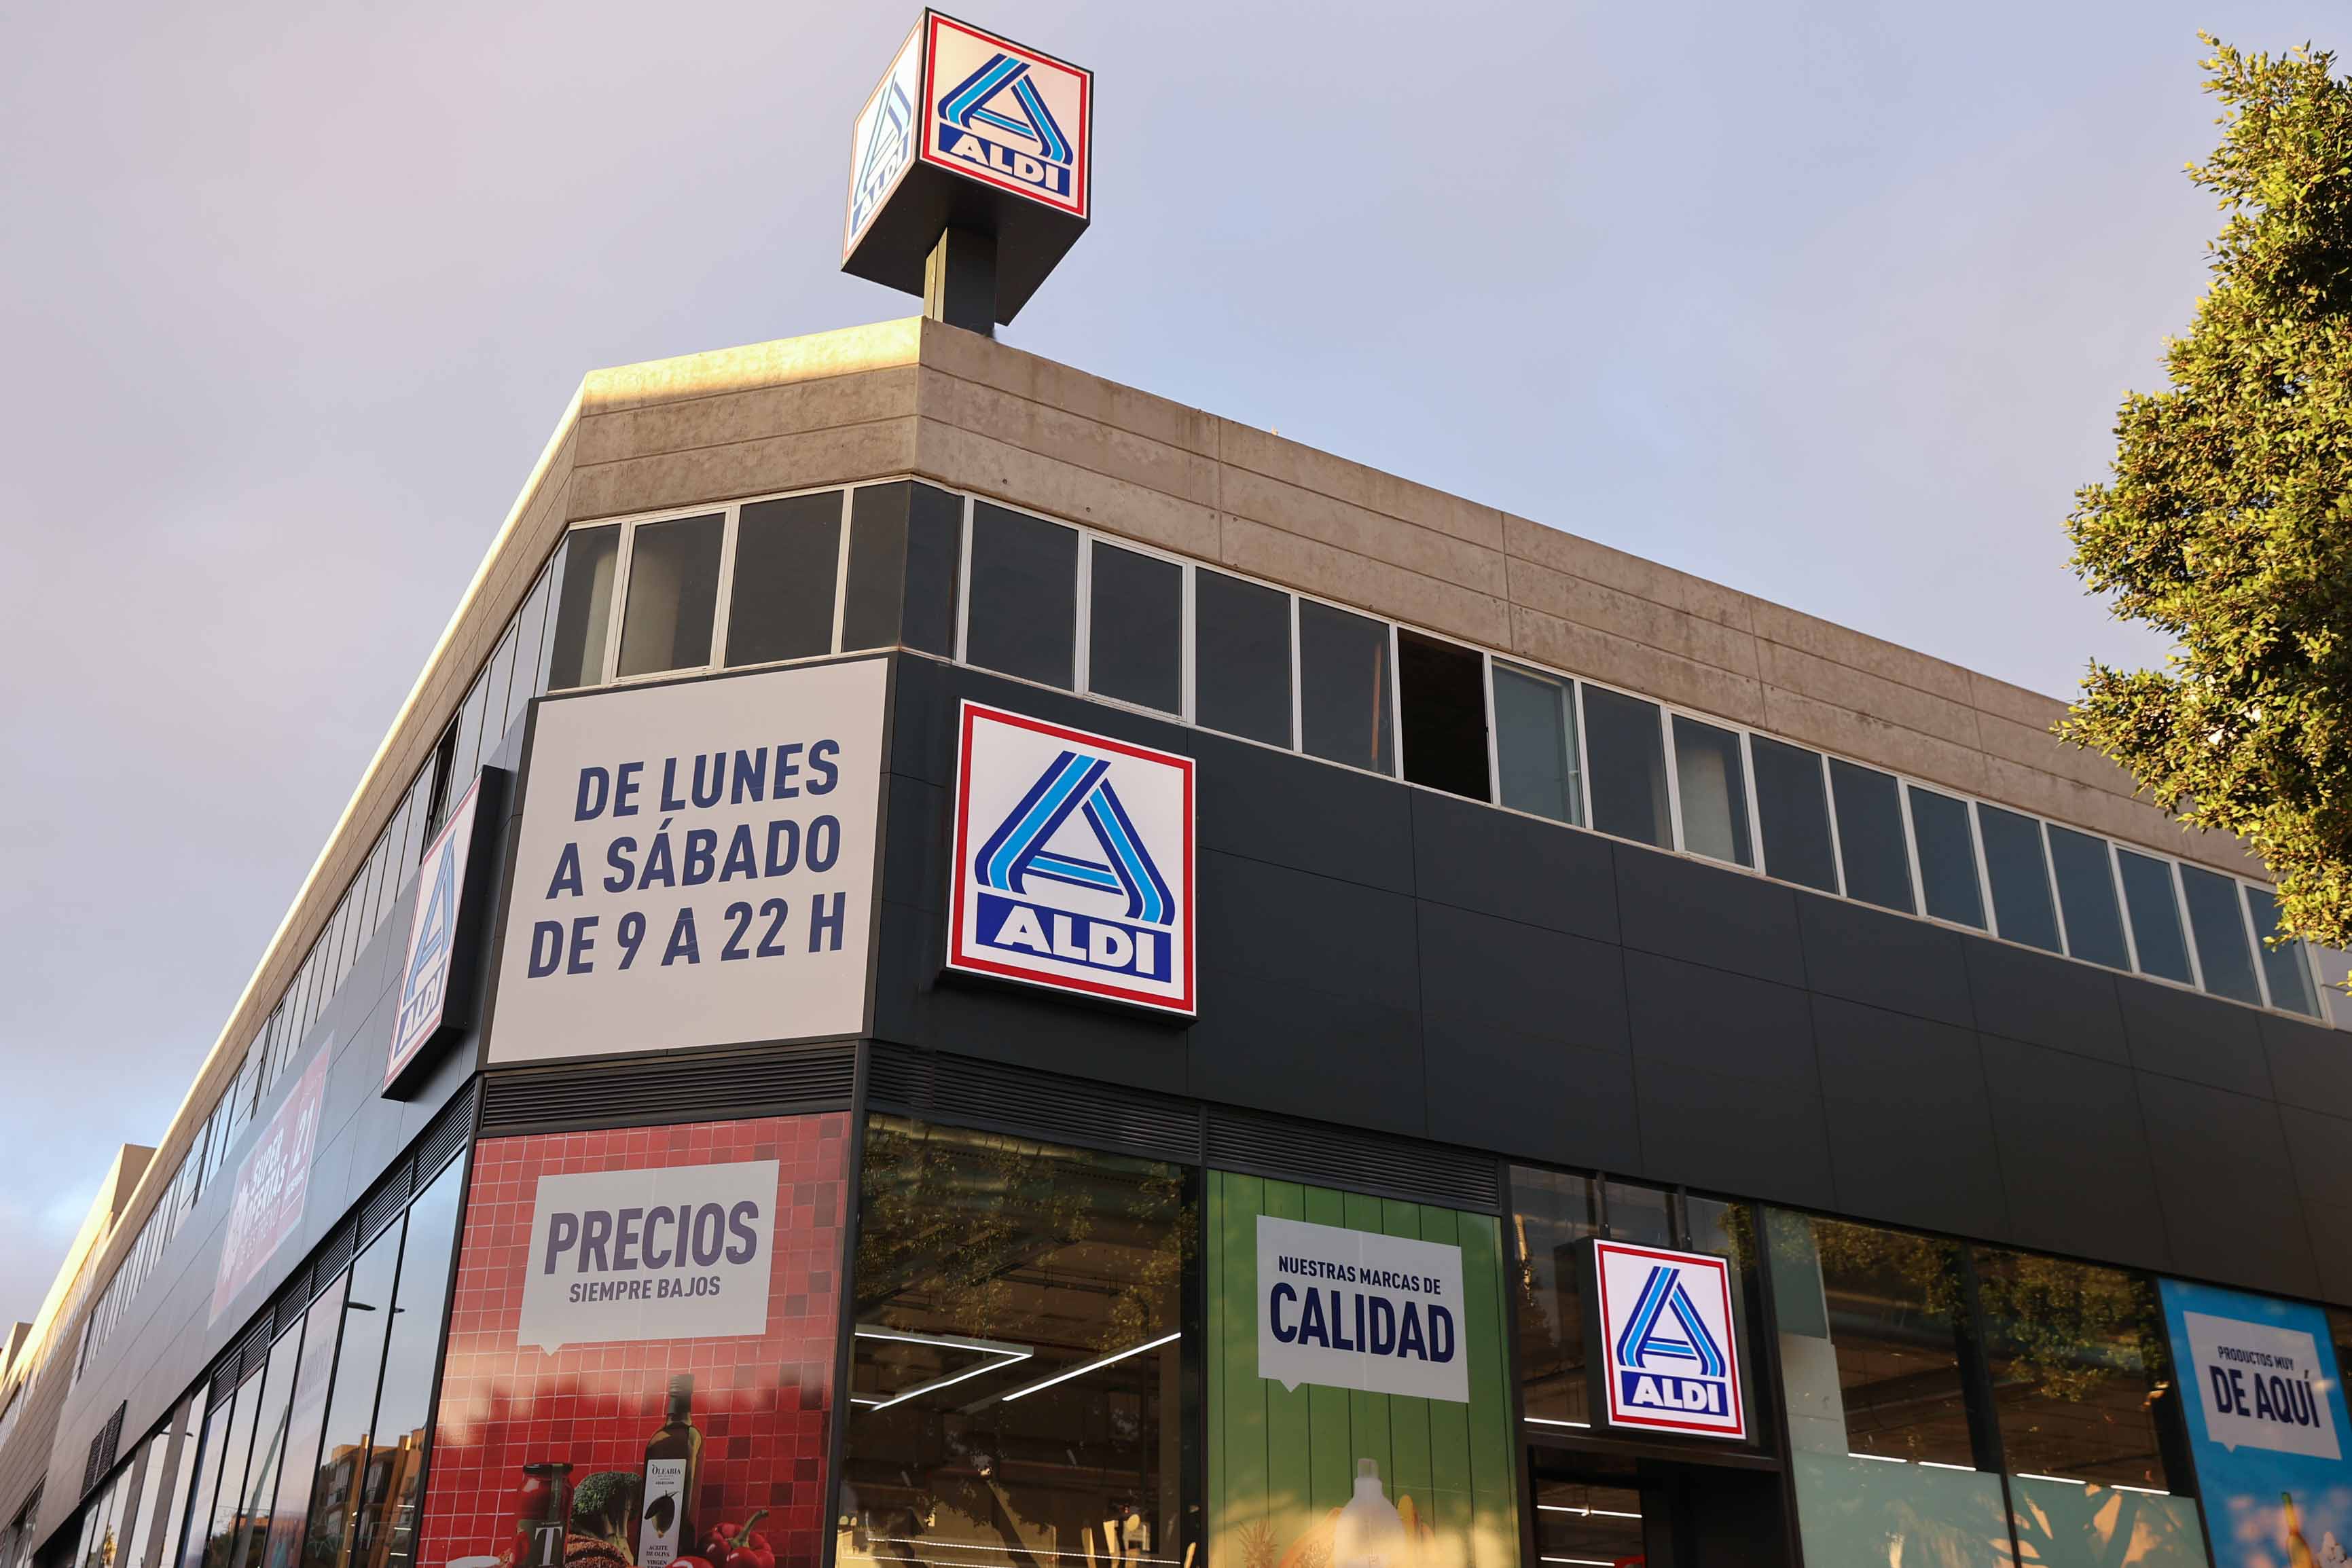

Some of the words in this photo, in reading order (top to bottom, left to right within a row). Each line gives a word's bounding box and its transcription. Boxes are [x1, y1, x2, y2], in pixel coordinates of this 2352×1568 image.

[856, 140, 904, 231] ALDI
[950, 133, 1059, 191] ALDI
[574, 761, 645, 822] DE
[659, 739, 840, 813] LUNES
[545, 842, 584, 900] A
[603, 814, 842, 894] SÁBADO
[527, 915, 600, 979] DE
[617, 911, 647, 971] 9
[661, 907, 702, 967] A
[721, 897, 789, 962] 22
[808, 891, 847, 953] H
[992, 905, 1155, 976] ALDI
[397, 966, 443, 1052] ALDI
[243, 1152, 289, 1237] OFERTAS
[251, 1127, 284, 1196] SUPER
[543, 1199, 759, 1275] PRECIOS
[568, 1279, 653, 1303] SIEMPRE
[657, 1275, 721, 1299] BAJOS
[1278, 1255, 1356, 1283] NUESTRAS
[1360, 1267, 1419, 1292] MARCAS
[1424, 1277, 1441, 1296] DE
[1270, 1281, 1455, 1364] CALIDAD
[2217, 1345, 2274, 1368] PRODUCTOS
[2274, 1355, 2294, 1371] MUY
[1631, 1375, 1721, 1414] ALDI
[2209, 1364, 2251, 1417] DE
[2254, 1369, 2321, 1429] AQUÍ
